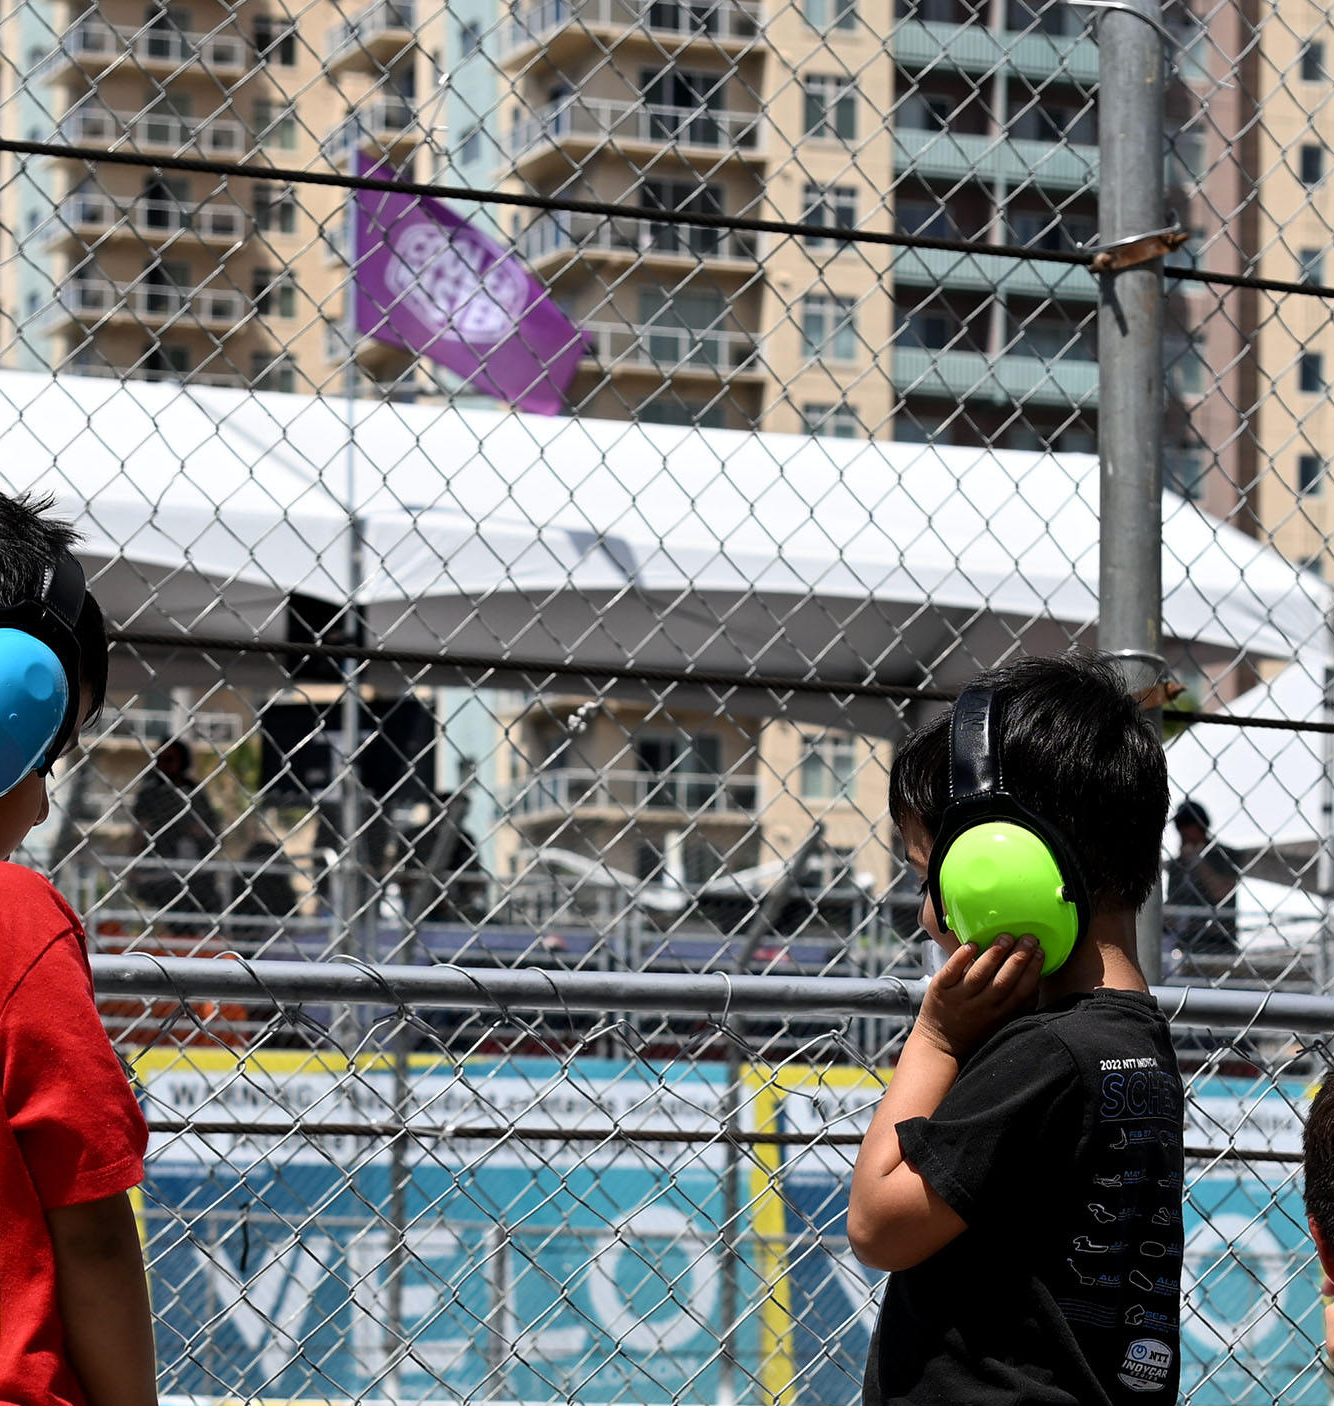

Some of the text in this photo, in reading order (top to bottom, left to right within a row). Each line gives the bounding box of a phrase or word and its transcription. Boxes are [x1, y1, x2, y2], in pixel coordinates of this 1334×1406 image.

[1100, 1060, 1122, 1071] 2022
[1123, 1058, 1137, 1069] NTT
[193, 1203, 721, 1388] VELO
[1149, 1350, 1169, 1363] NTT
[1122, 1359, 1168, 1379] INDYCAR
